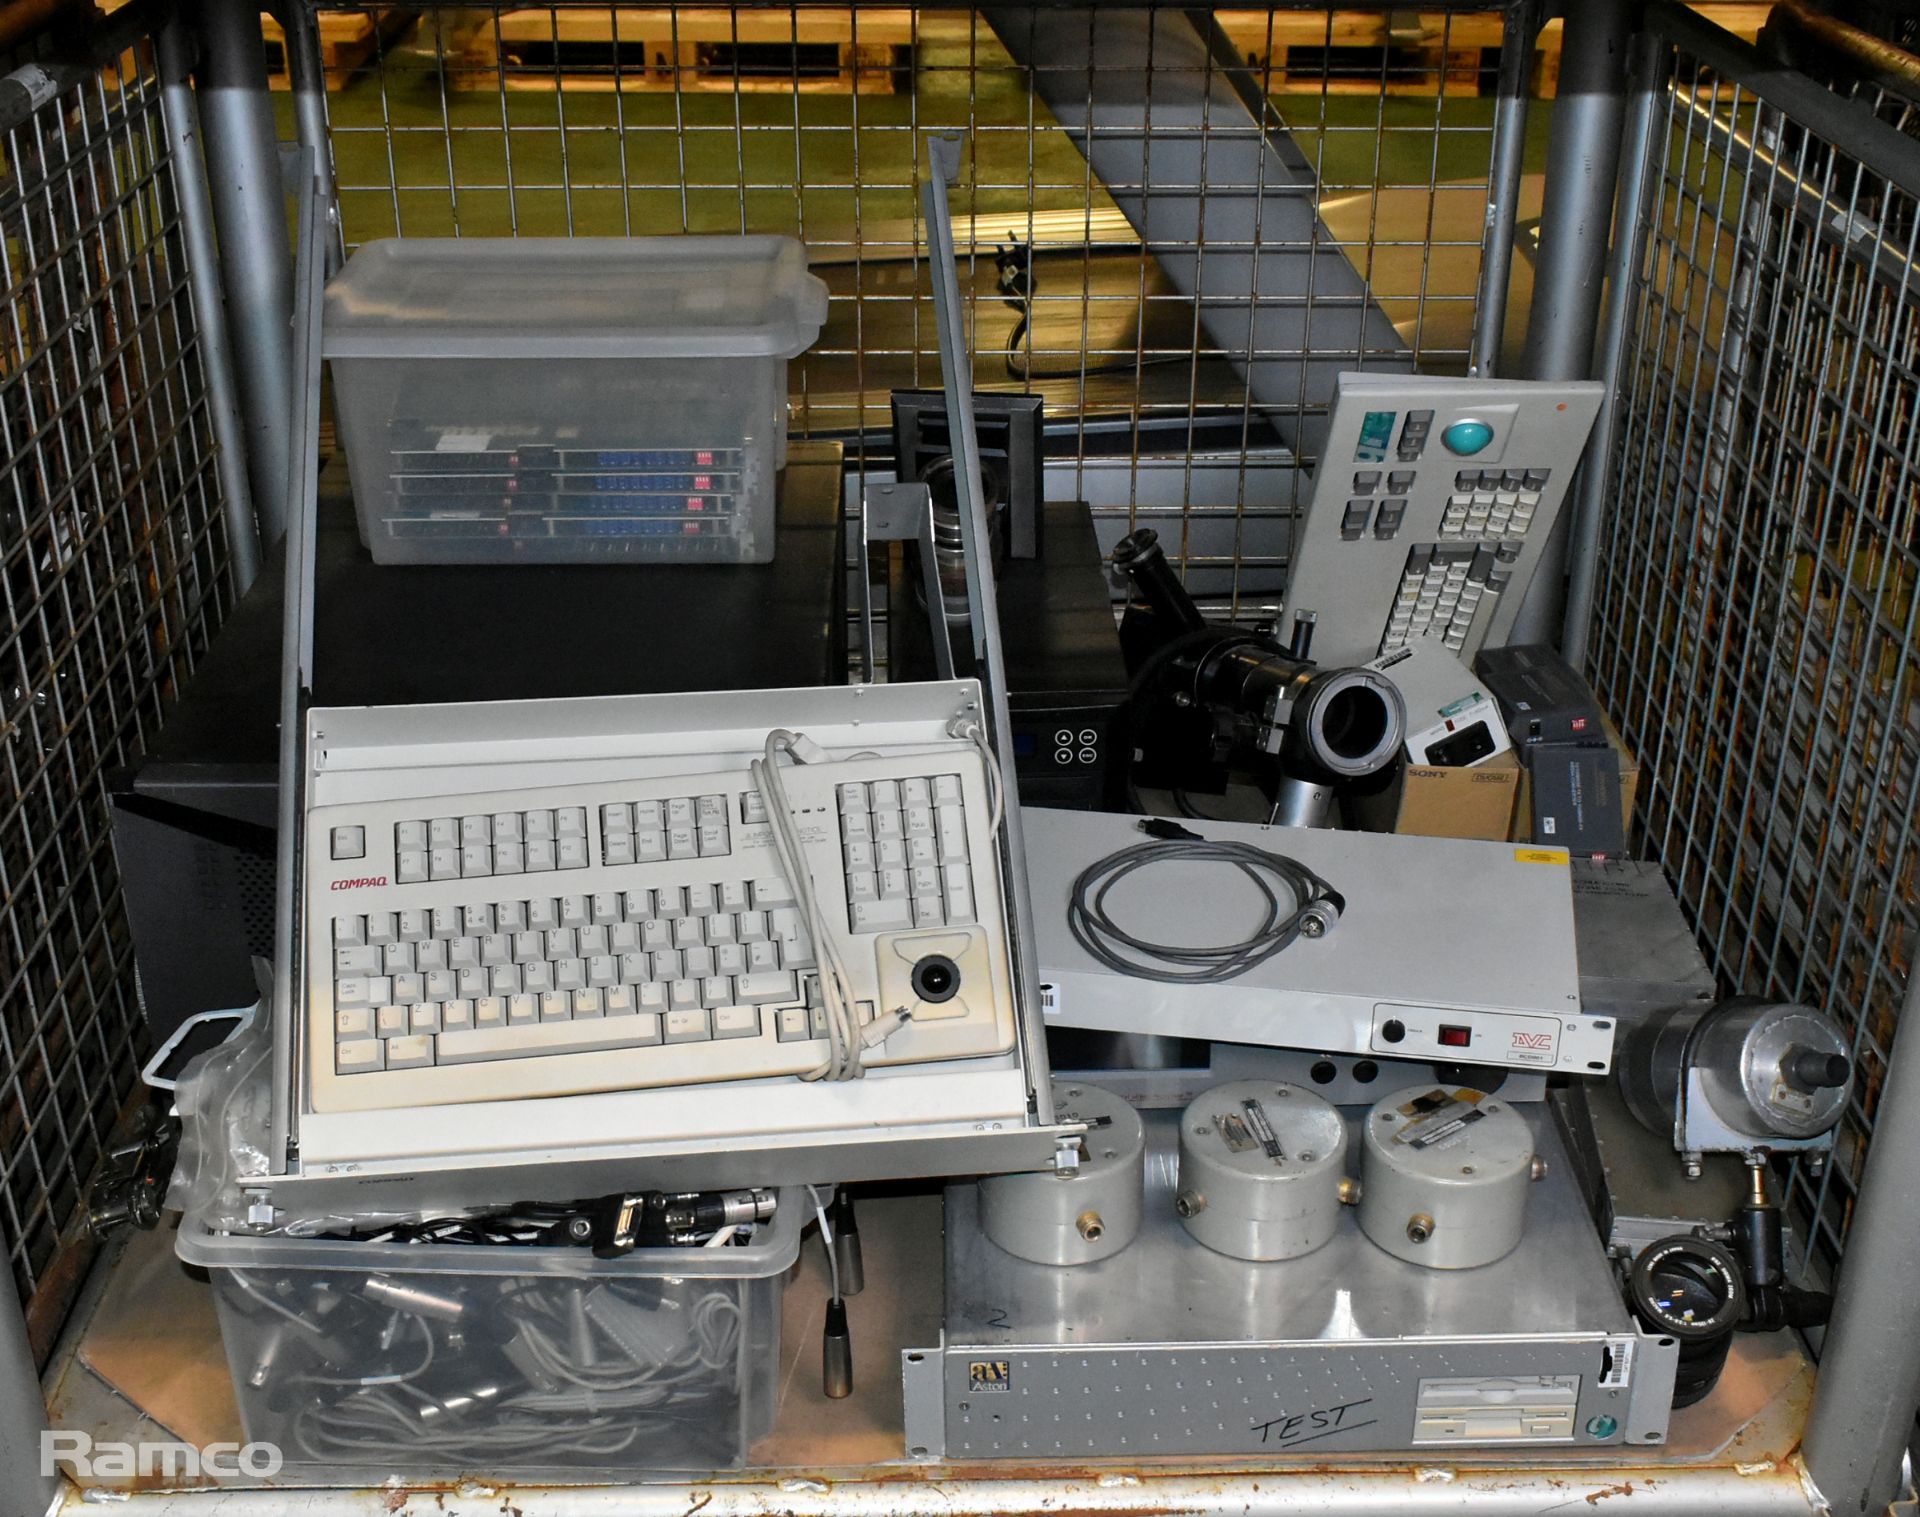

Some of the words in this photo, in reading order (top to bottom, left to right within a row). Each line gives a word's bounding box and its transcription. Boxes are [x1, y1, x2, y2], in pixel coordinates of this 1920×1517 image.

[1408, 769, 1447, 778] SONY
[330, 876, 388, 891] COMPAQ
[987, 1308, 1011, 1329] 2
[973, 1381, 1007, 1391] Aston
[1251, 1398, 1372, 1443] TEST
